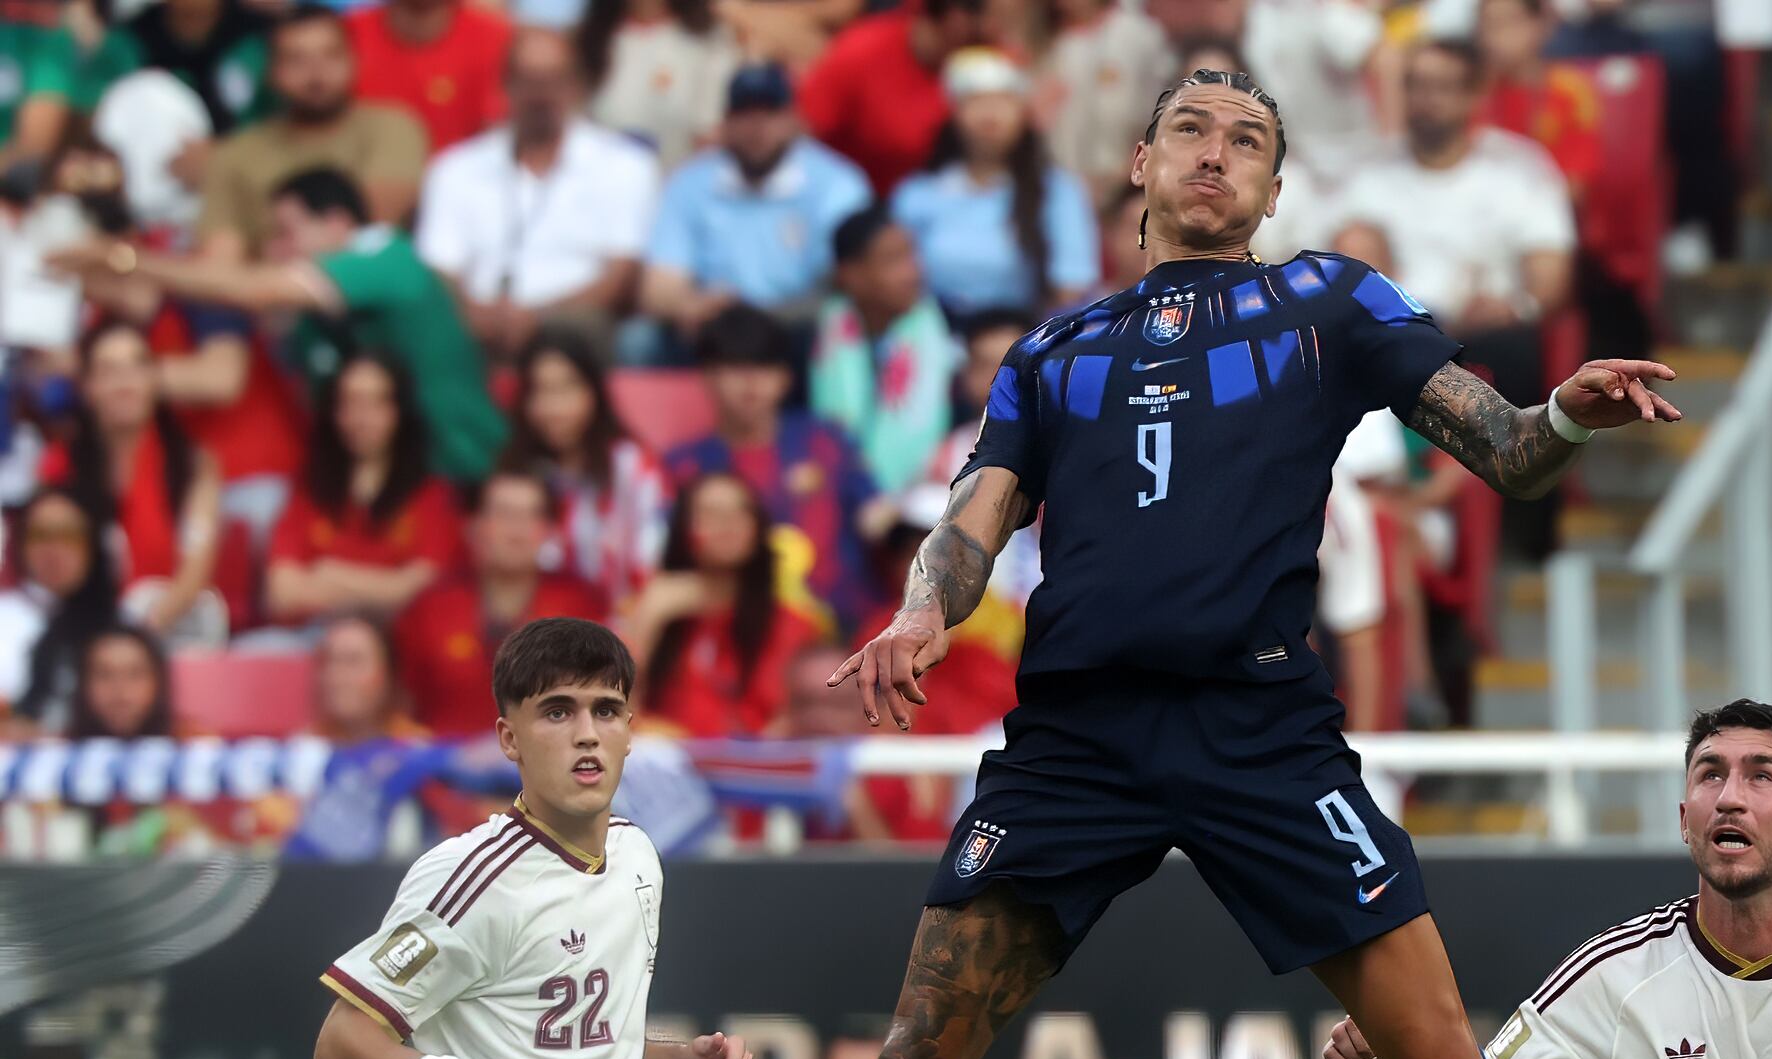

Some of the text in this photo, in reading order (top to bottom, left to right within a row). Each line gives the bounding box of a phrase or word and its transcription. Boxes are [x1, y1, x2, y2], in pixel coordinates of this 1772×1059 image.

[1137, 422, 1172, 507] 9
[1315, 789, 1386, 877] 9
[534, 968, 615, 1050] 22
